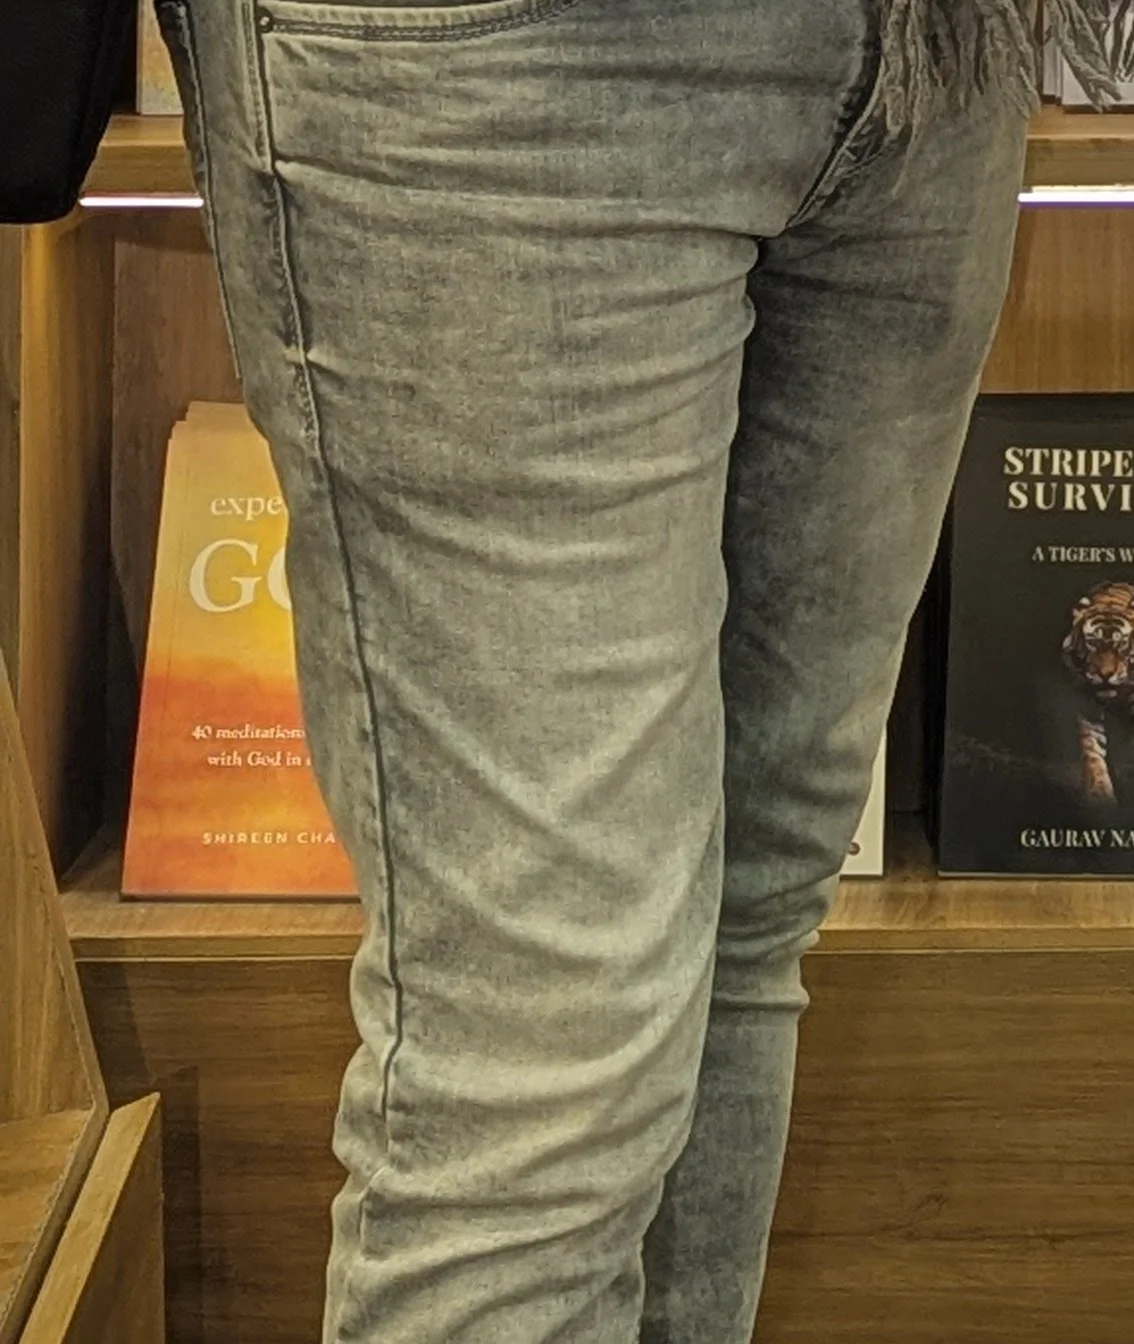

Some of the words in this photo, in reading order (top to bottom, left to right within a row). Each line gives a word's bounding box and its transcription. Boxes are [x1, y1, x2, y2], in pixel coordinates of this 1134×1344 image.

[1032, 546, 1044, 561] A
[192, 725, 212, 739] 40
[207, 751, 242, 766] with
[247, 750, 282, 766] God
[286, 751, 302, 766] in
[202, 832, 288, 845] SHIREEN
[1021, 829, 1106, 848] GAURAV
